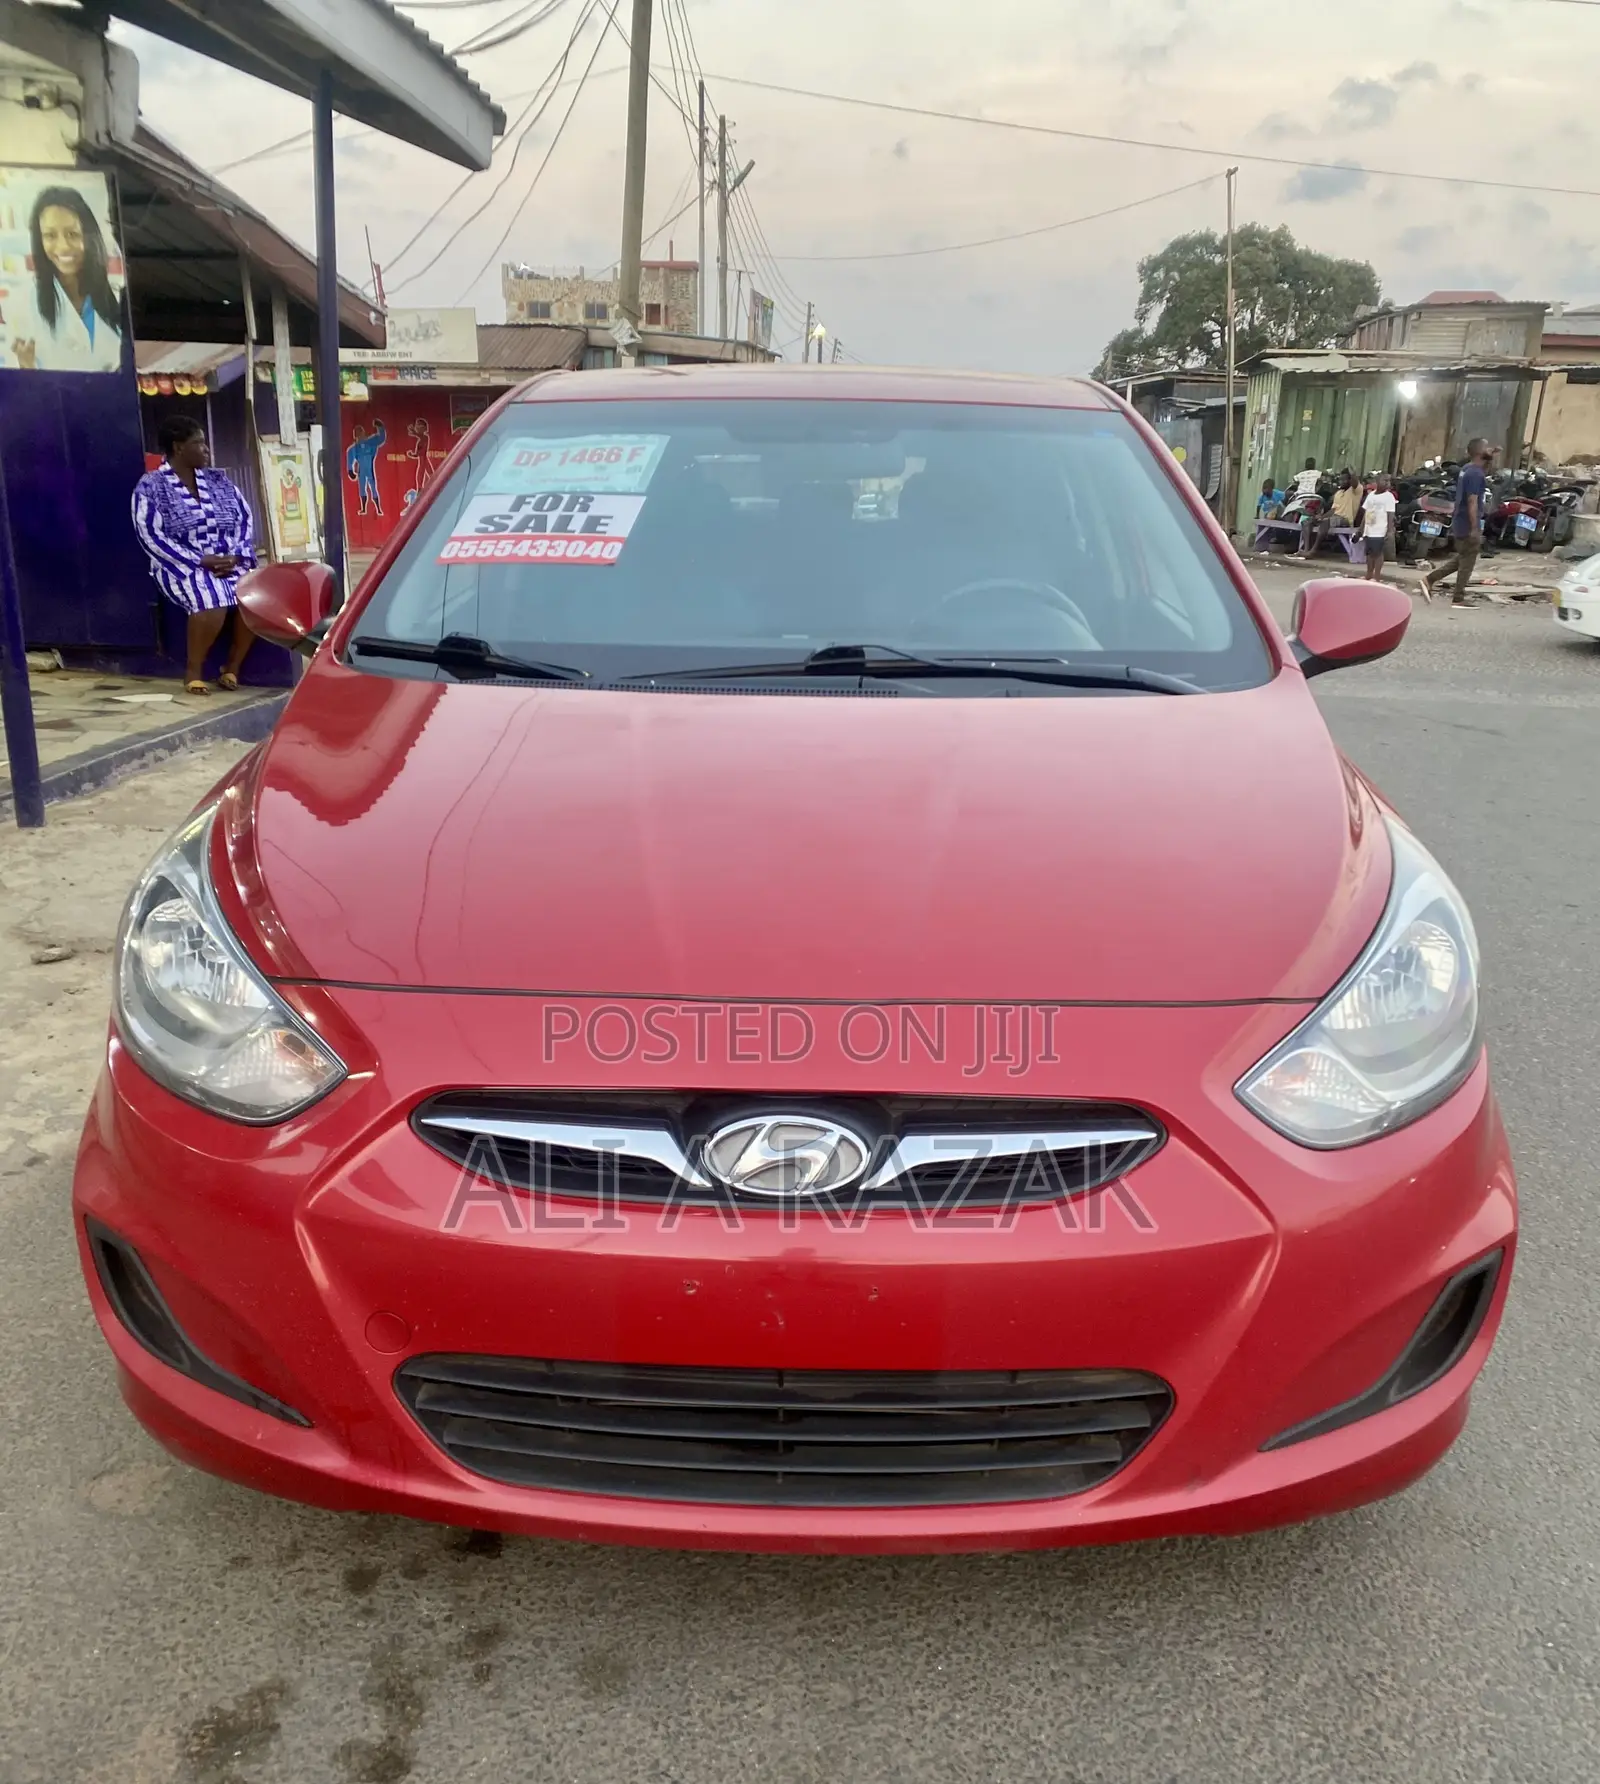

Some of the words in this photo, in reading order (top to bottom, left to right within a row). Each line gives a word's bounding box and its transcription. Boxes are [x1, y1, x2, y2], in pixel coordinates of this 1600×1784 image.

[512, 449, 552, 467] DP
[557, 447, 624, 466] 1466
[625, 446, 646, 463] F
[508, 493, 595, 513] FOR
[474, 514, 614, 534] SALE
[439, 539, 623, 560] 0555433040
